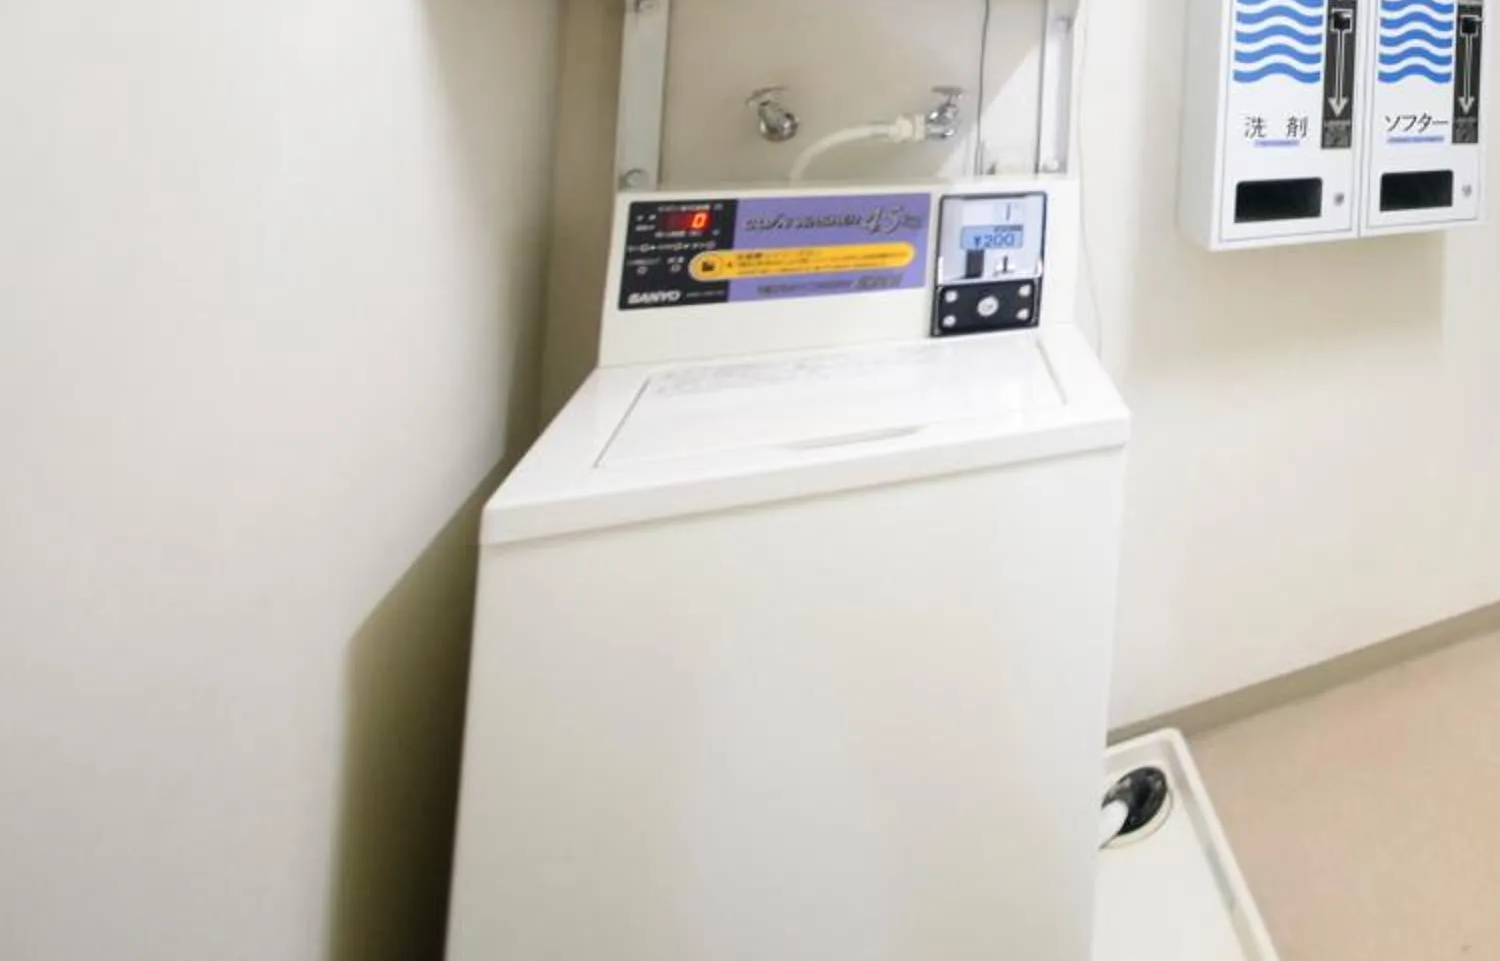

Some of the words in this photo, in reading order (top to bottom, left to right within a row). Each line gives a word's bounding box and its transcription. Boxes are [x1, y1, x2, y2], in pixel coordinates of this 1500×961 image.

[1244, 115, 1309, 139] 洗剤
[1384, 112, 1449, 133] ソフター
[628, 290, 681, 304] SANYO
